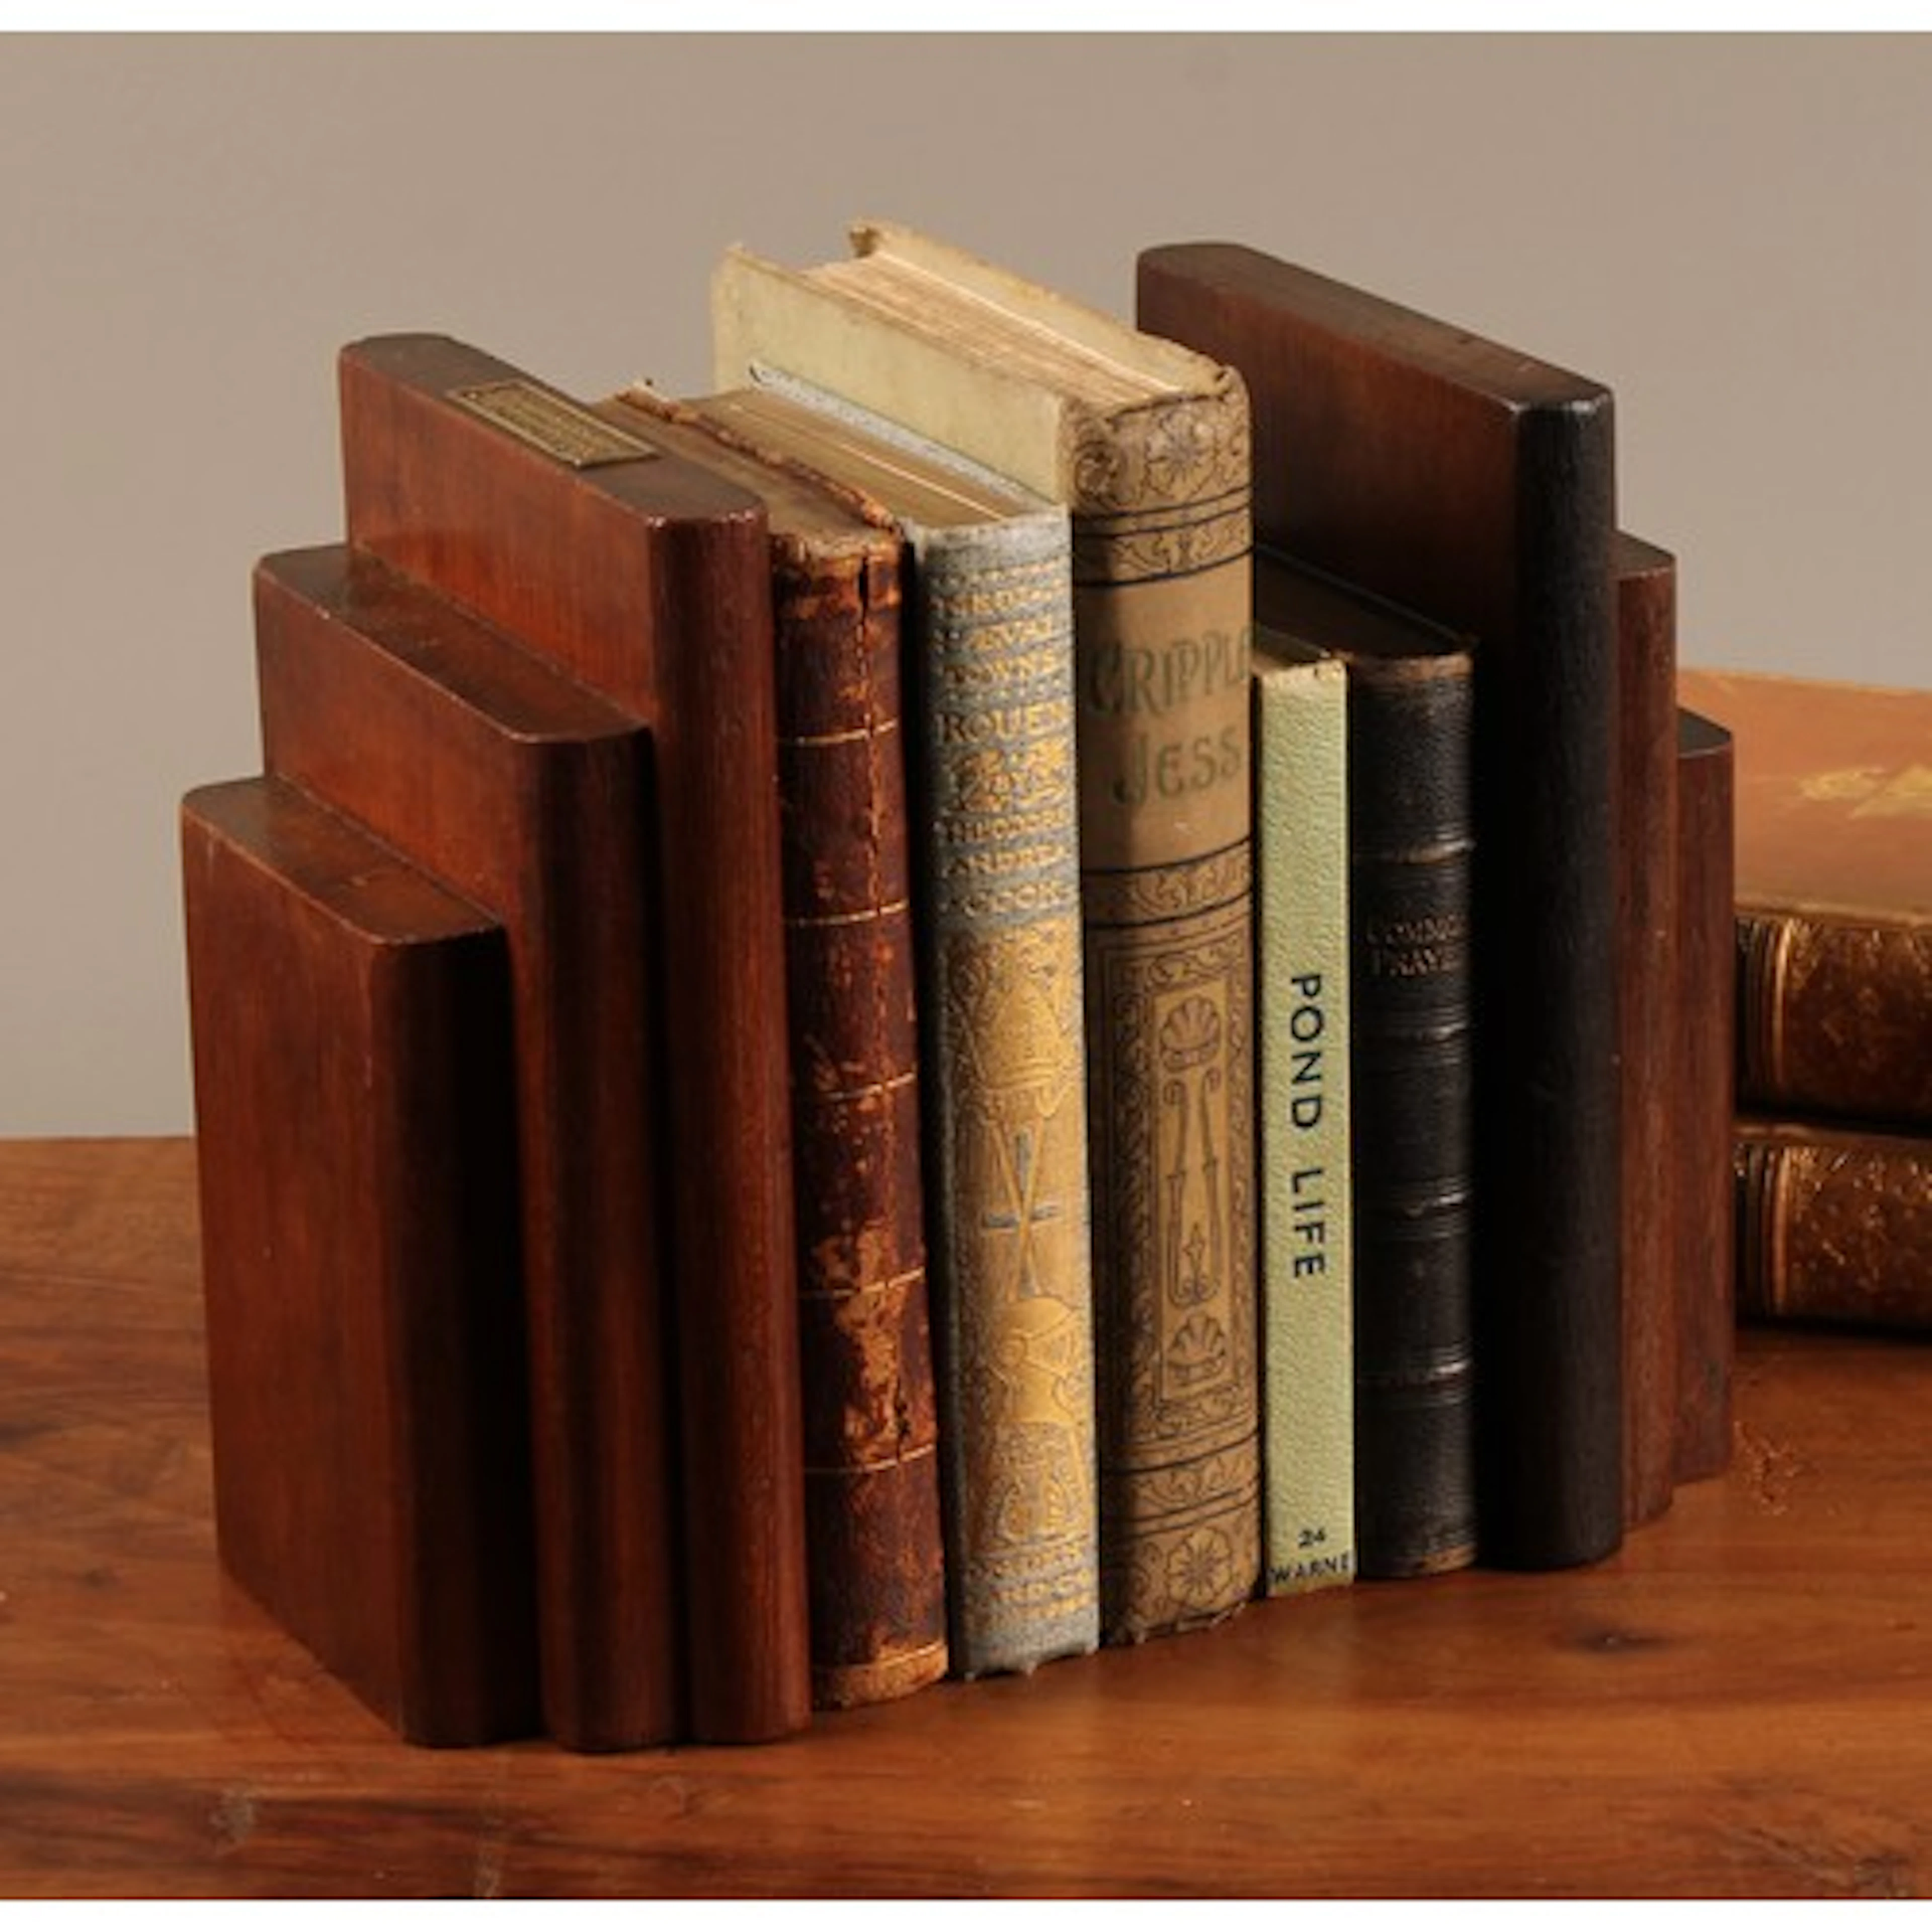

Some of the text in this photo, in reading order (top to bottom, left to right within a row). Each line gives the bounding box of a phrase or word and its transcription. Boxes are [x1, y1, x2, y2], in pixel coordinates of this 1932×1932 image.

[934, 700, 1070, 745] ROUEN
[1112, 726, 1242, 806] JESS
[1291, 974, 1325, 1278] POND LIFE
